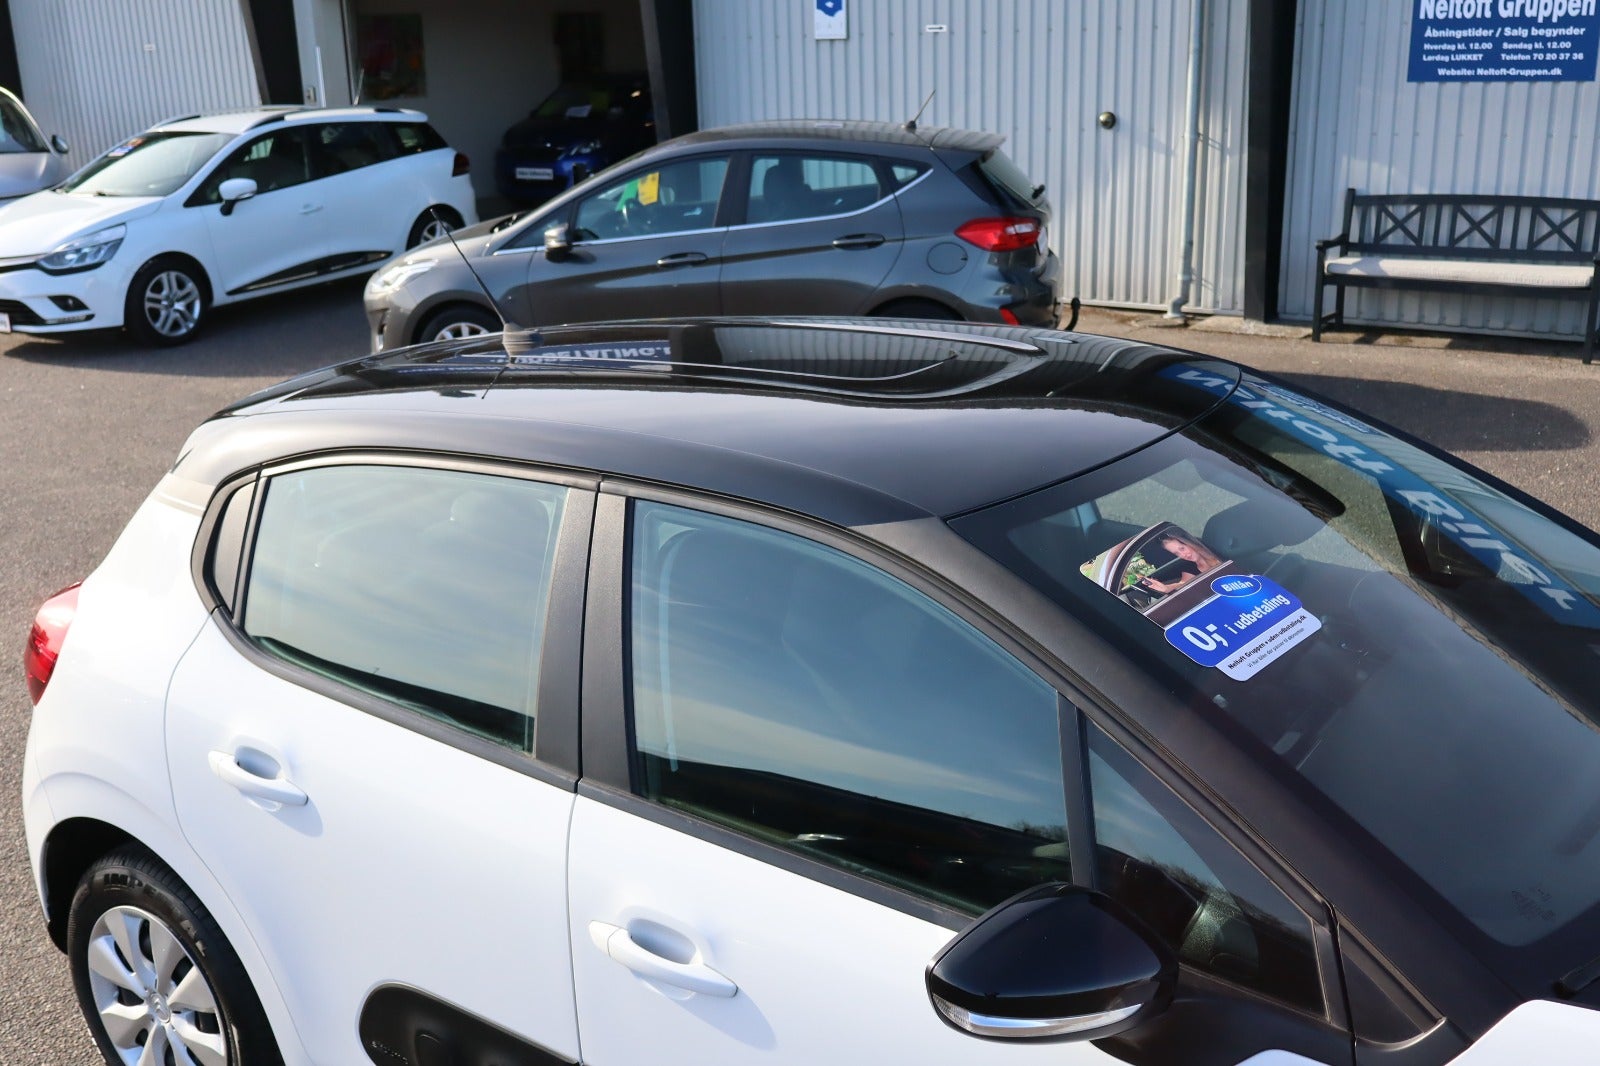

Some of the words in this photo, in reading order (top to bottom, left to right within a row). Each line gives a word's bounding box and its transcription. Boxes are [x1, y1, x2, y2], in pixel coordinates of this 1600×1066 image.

[1419, 0, 1492, 19] Neltoft
[1497, 0, 1595, 23] Gruppen
[1424, 26, 1494, 38] Åbningstider
[1495, 27, 1502, 38] /
[1504, 26, 1529, 38] Salg
[1531, 26, 1586, 38] begynder
[1469, 42, 1493, 50] 12.00
[1547, 41, 1572, 49] 12.00
[1501, 53, 1531, 61] Telefon
[1532, 53, 1544, 61] 70
[1476, 67, 1562, 77] Neltoft-Gruppen.dk
[1221, 580, 1254, 592] Billån
[1223, 624, 1238, 635] i
[1233, 594, 1291, 630] udbetaling
